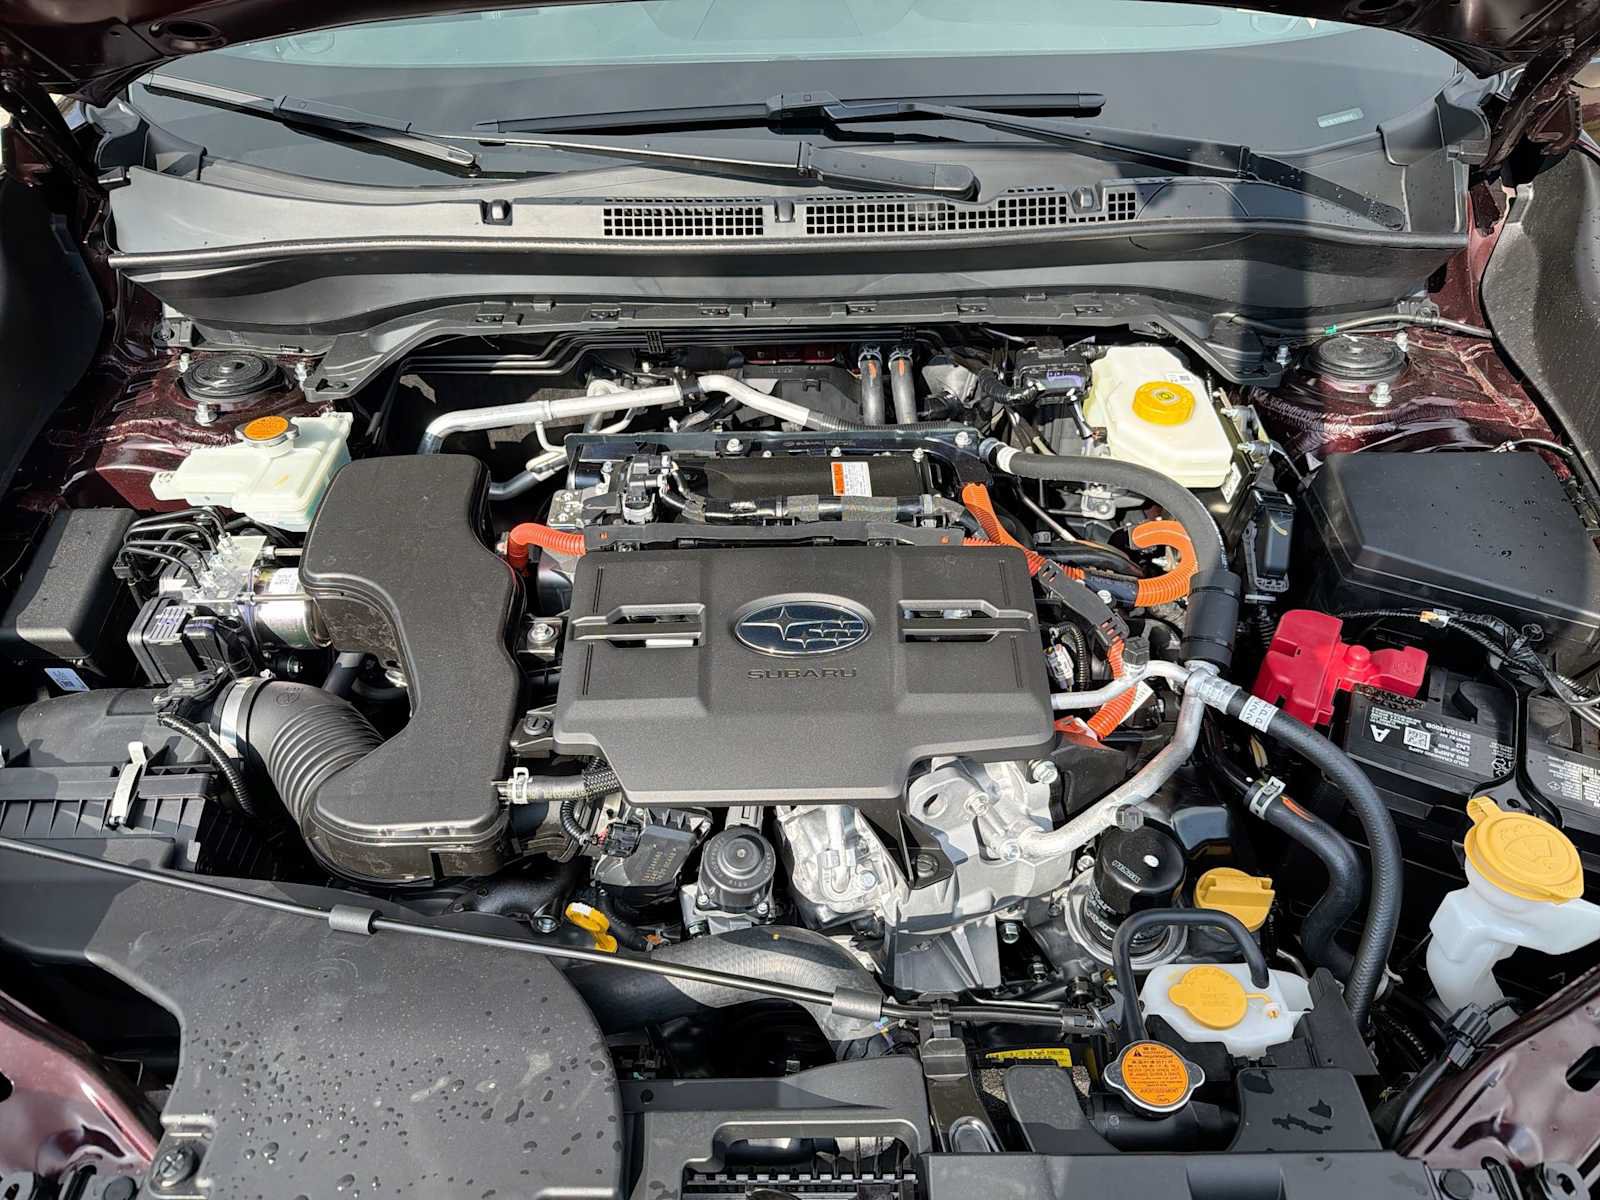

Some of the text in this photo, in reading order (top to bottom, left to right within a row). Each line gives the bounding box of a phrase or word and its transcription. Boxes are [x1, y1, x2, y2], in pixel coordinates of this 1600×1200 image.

[747, 667, 857, 679] SUBARU
[1370, 724, 1390, 742] A
[1433, 747, 1456, 758] AMPS
[1456, 743, 1470, 751] LN2
